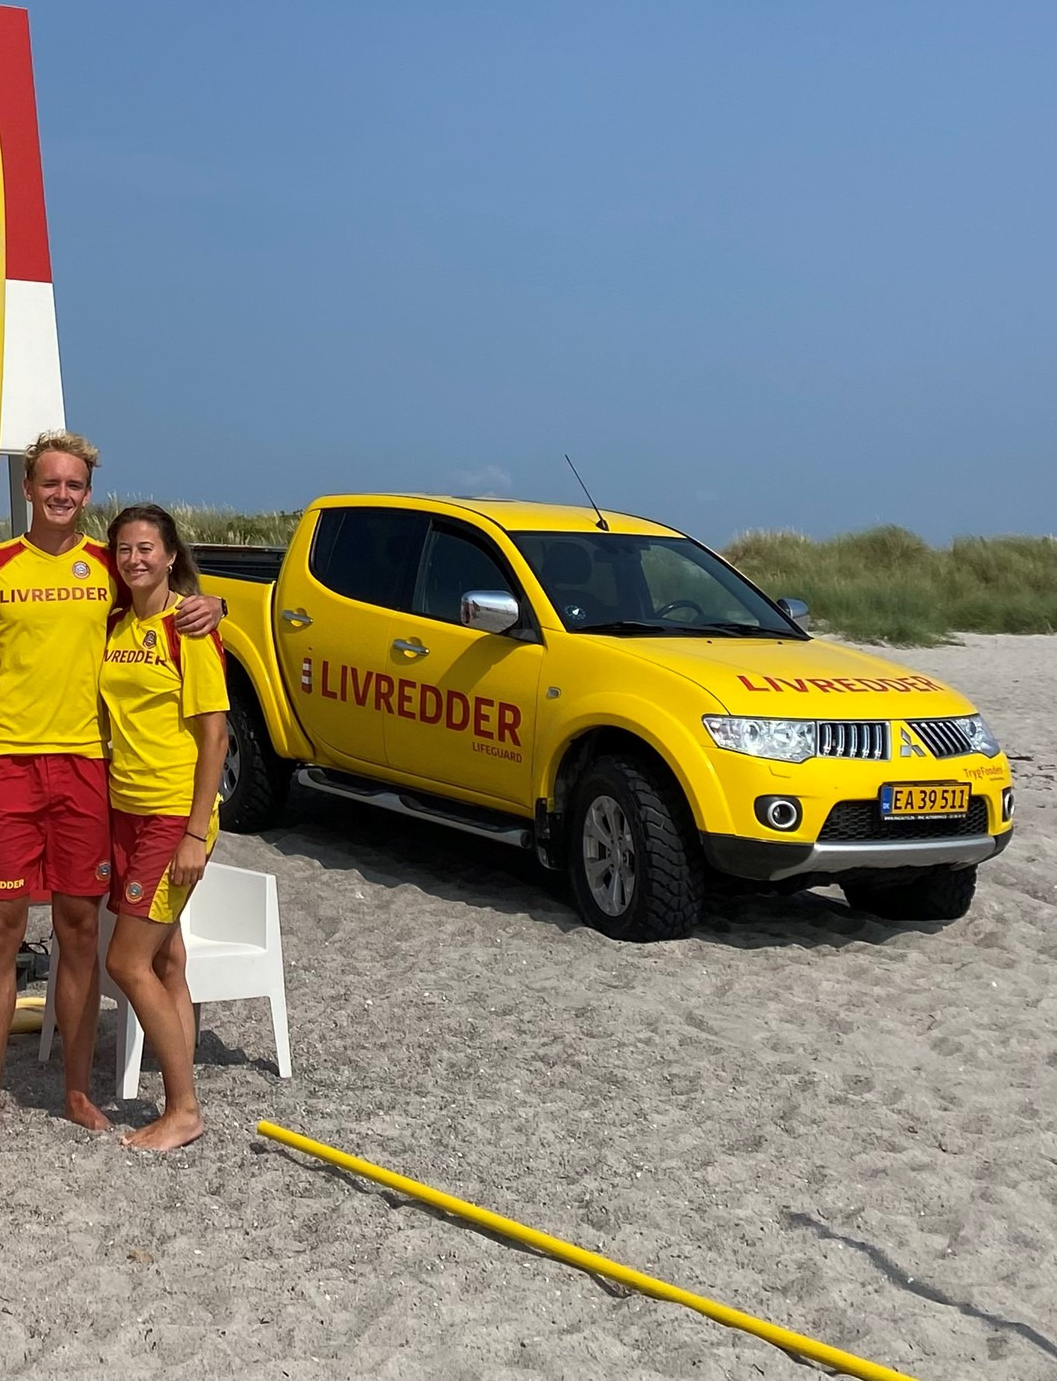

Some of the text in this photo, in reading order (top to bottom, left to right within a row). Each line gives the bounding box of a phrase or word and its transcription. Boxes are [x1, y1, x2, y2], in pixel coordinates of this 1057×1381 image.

[0, 586, 108, 604] LIVREDDER
[103, 649, 166, 666] VREDDER
[737, 675, 946, 694] LIVREDDER
[321, 660, 522, 747] LIVREDDER
[472, 741, 523, 764] LIFEGUARD
[894, 789, 965, 810] EA 39 511
